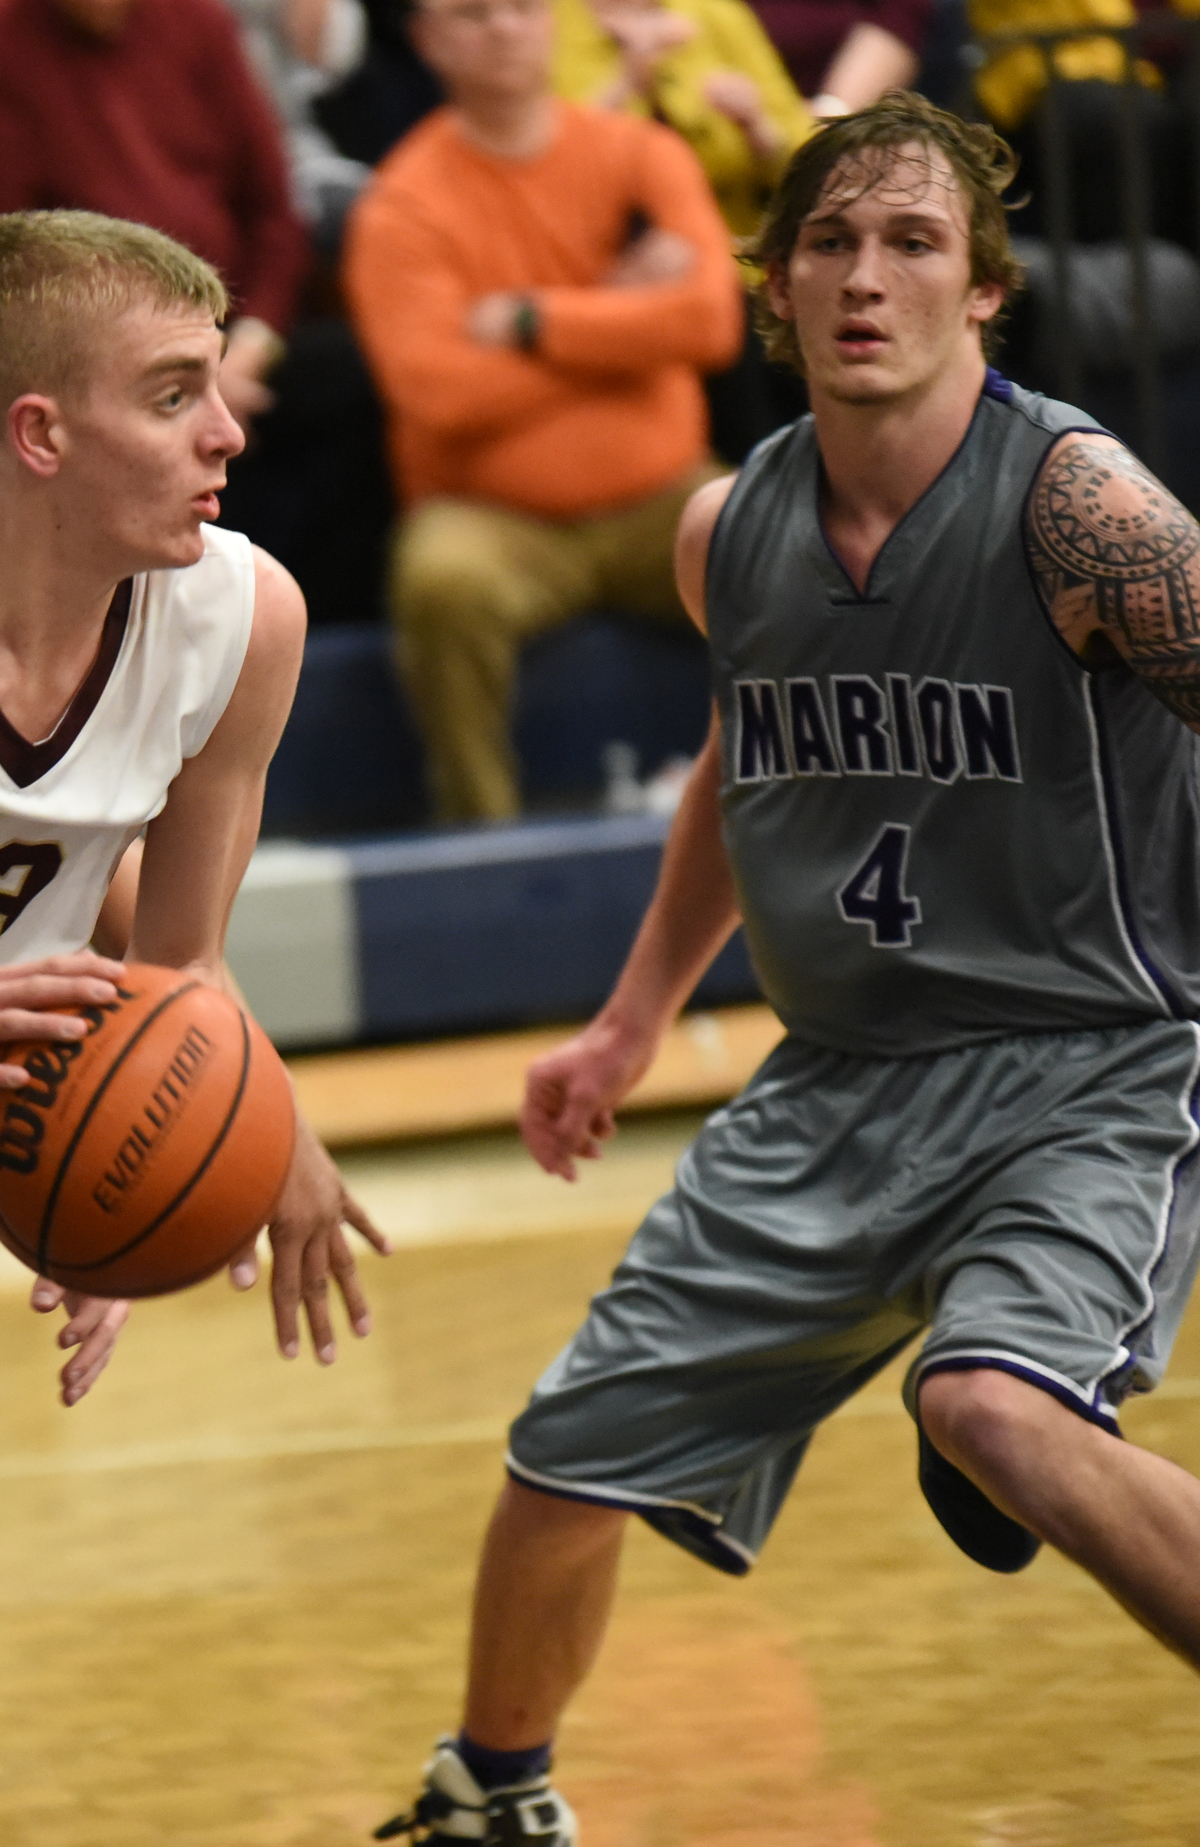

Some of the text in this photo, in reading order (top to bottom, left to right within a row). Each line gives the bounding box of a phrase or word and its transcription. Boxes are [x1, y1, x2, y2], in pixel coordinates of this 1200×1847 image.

[733, 672, 1024, 785] MARION
[836, 821, 923, 948] 4
[92, 1025, 212, 1215] EVOLUTION
